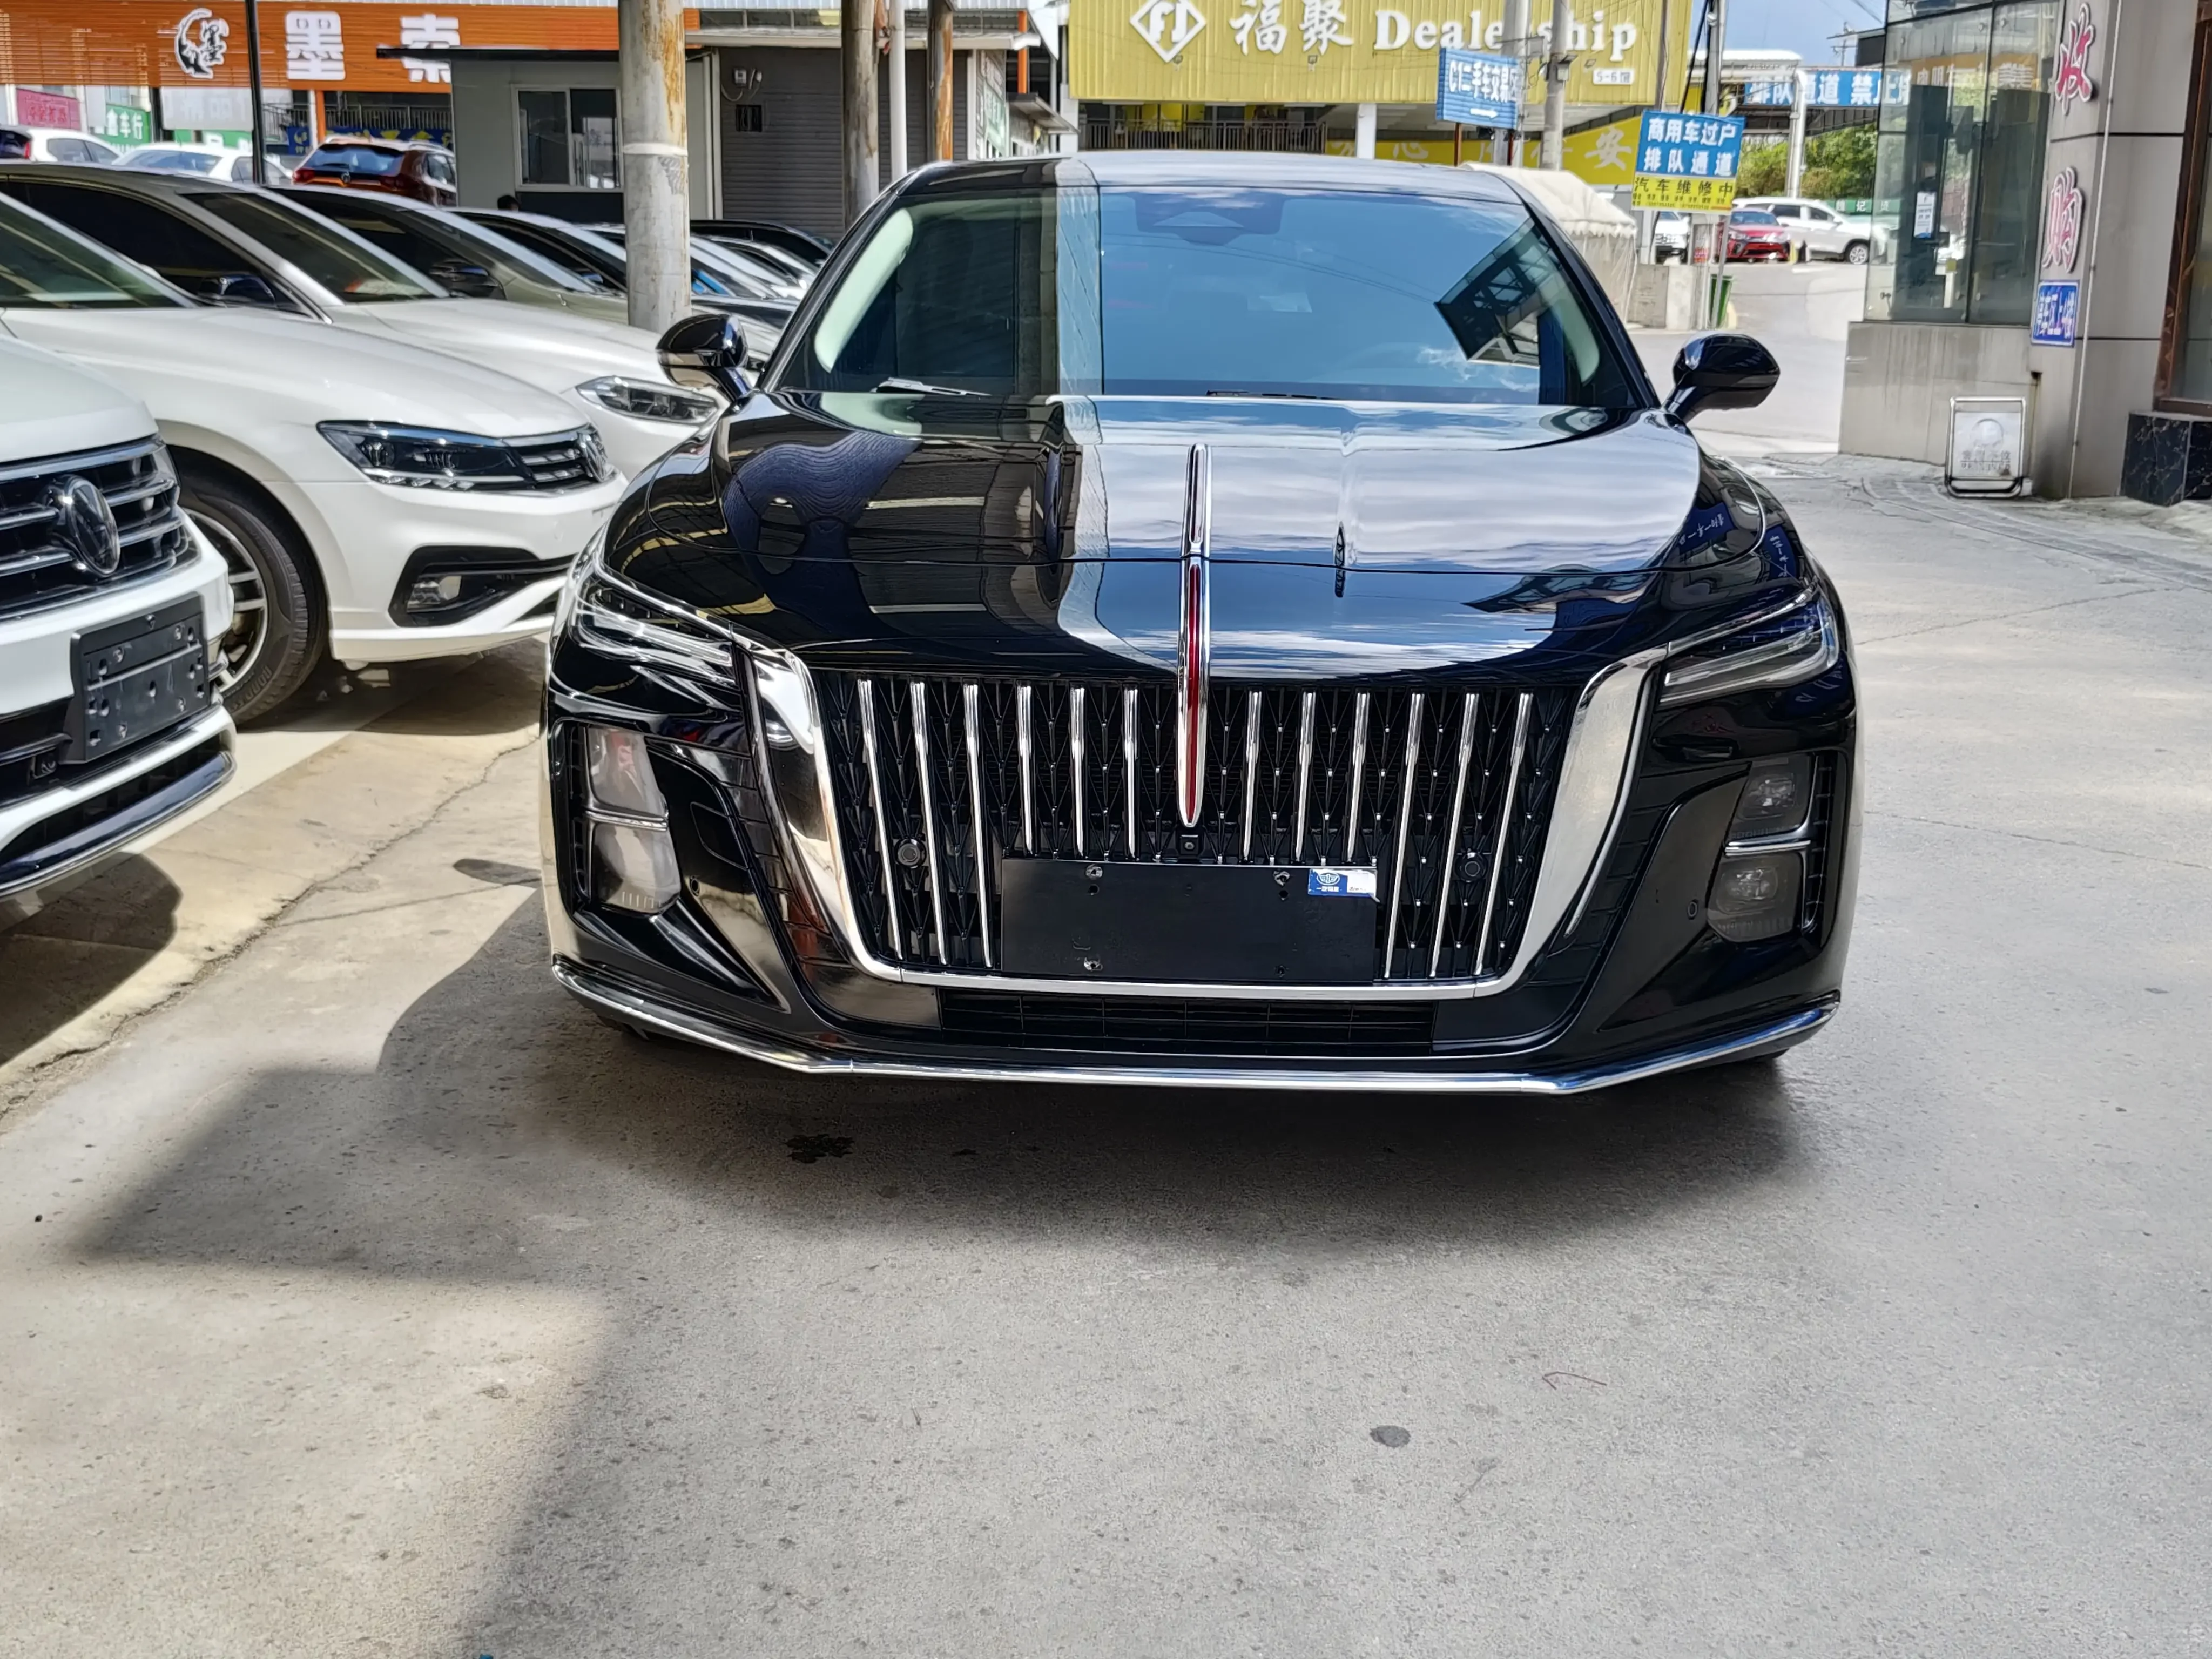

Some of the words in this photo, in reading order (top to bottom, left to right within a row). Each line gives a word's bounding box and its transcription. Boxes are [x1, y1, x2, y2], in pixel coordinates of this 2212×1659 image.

[1229, 0, 1354, 55] 福聚
[1373, 10, 1636, 61] Dealeship
[1648, 116, 1737, 147] 商用车过户
[1585, 127, 1632, 171] 安
[1643, 145, 1736, 177] 排队通道
[1634, 177, 1733, 198] 汽车维修中
